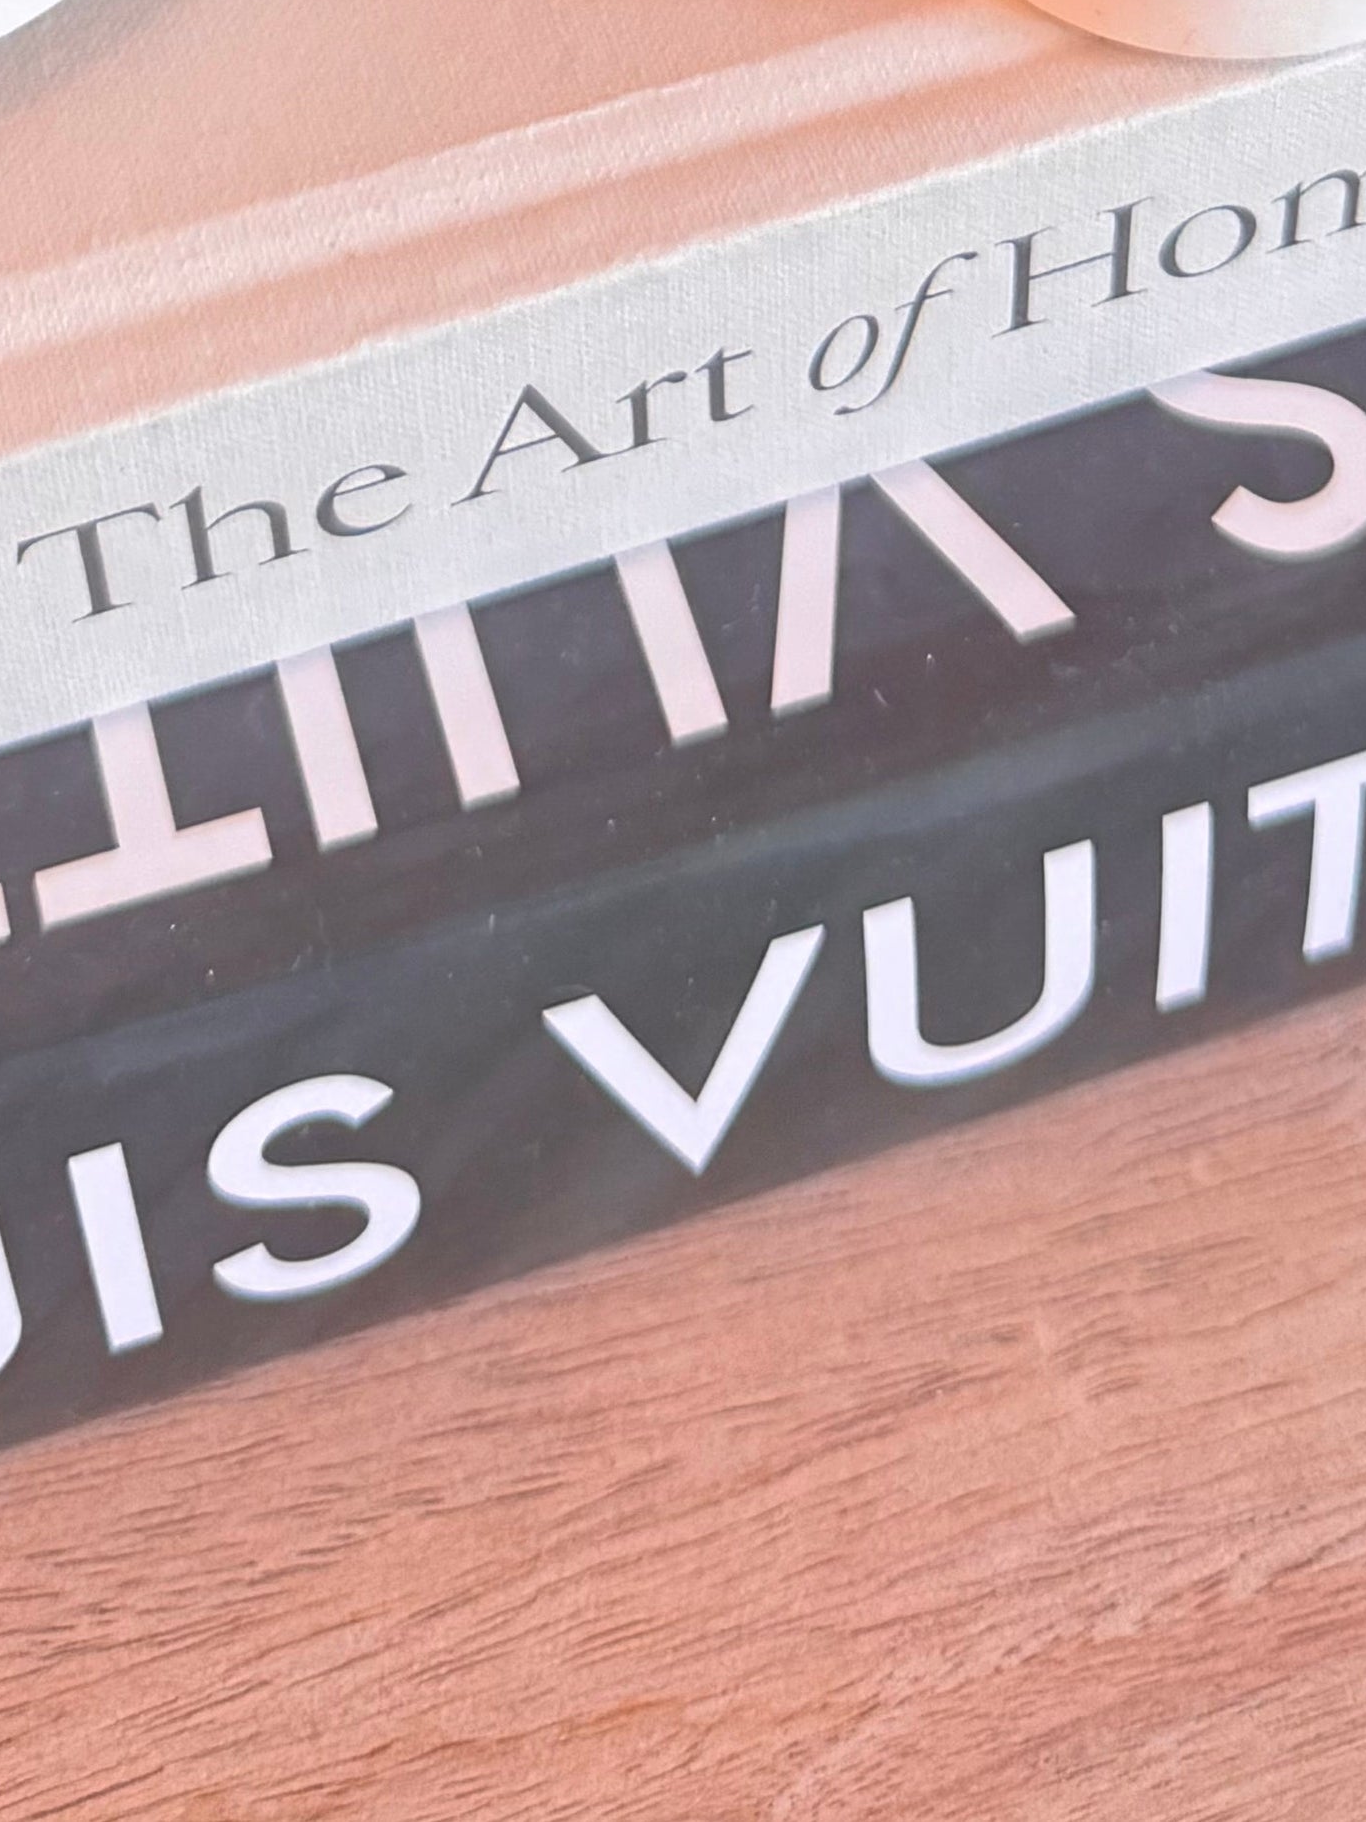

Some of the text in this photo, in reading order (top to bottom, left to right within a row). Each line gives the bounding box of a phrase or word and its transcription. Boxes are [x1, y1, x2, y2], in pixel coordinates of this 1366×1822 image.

[14, 462, 410, 626] The
[448, 338, 757, 503] Art
[807, 249, 980, 416] of
